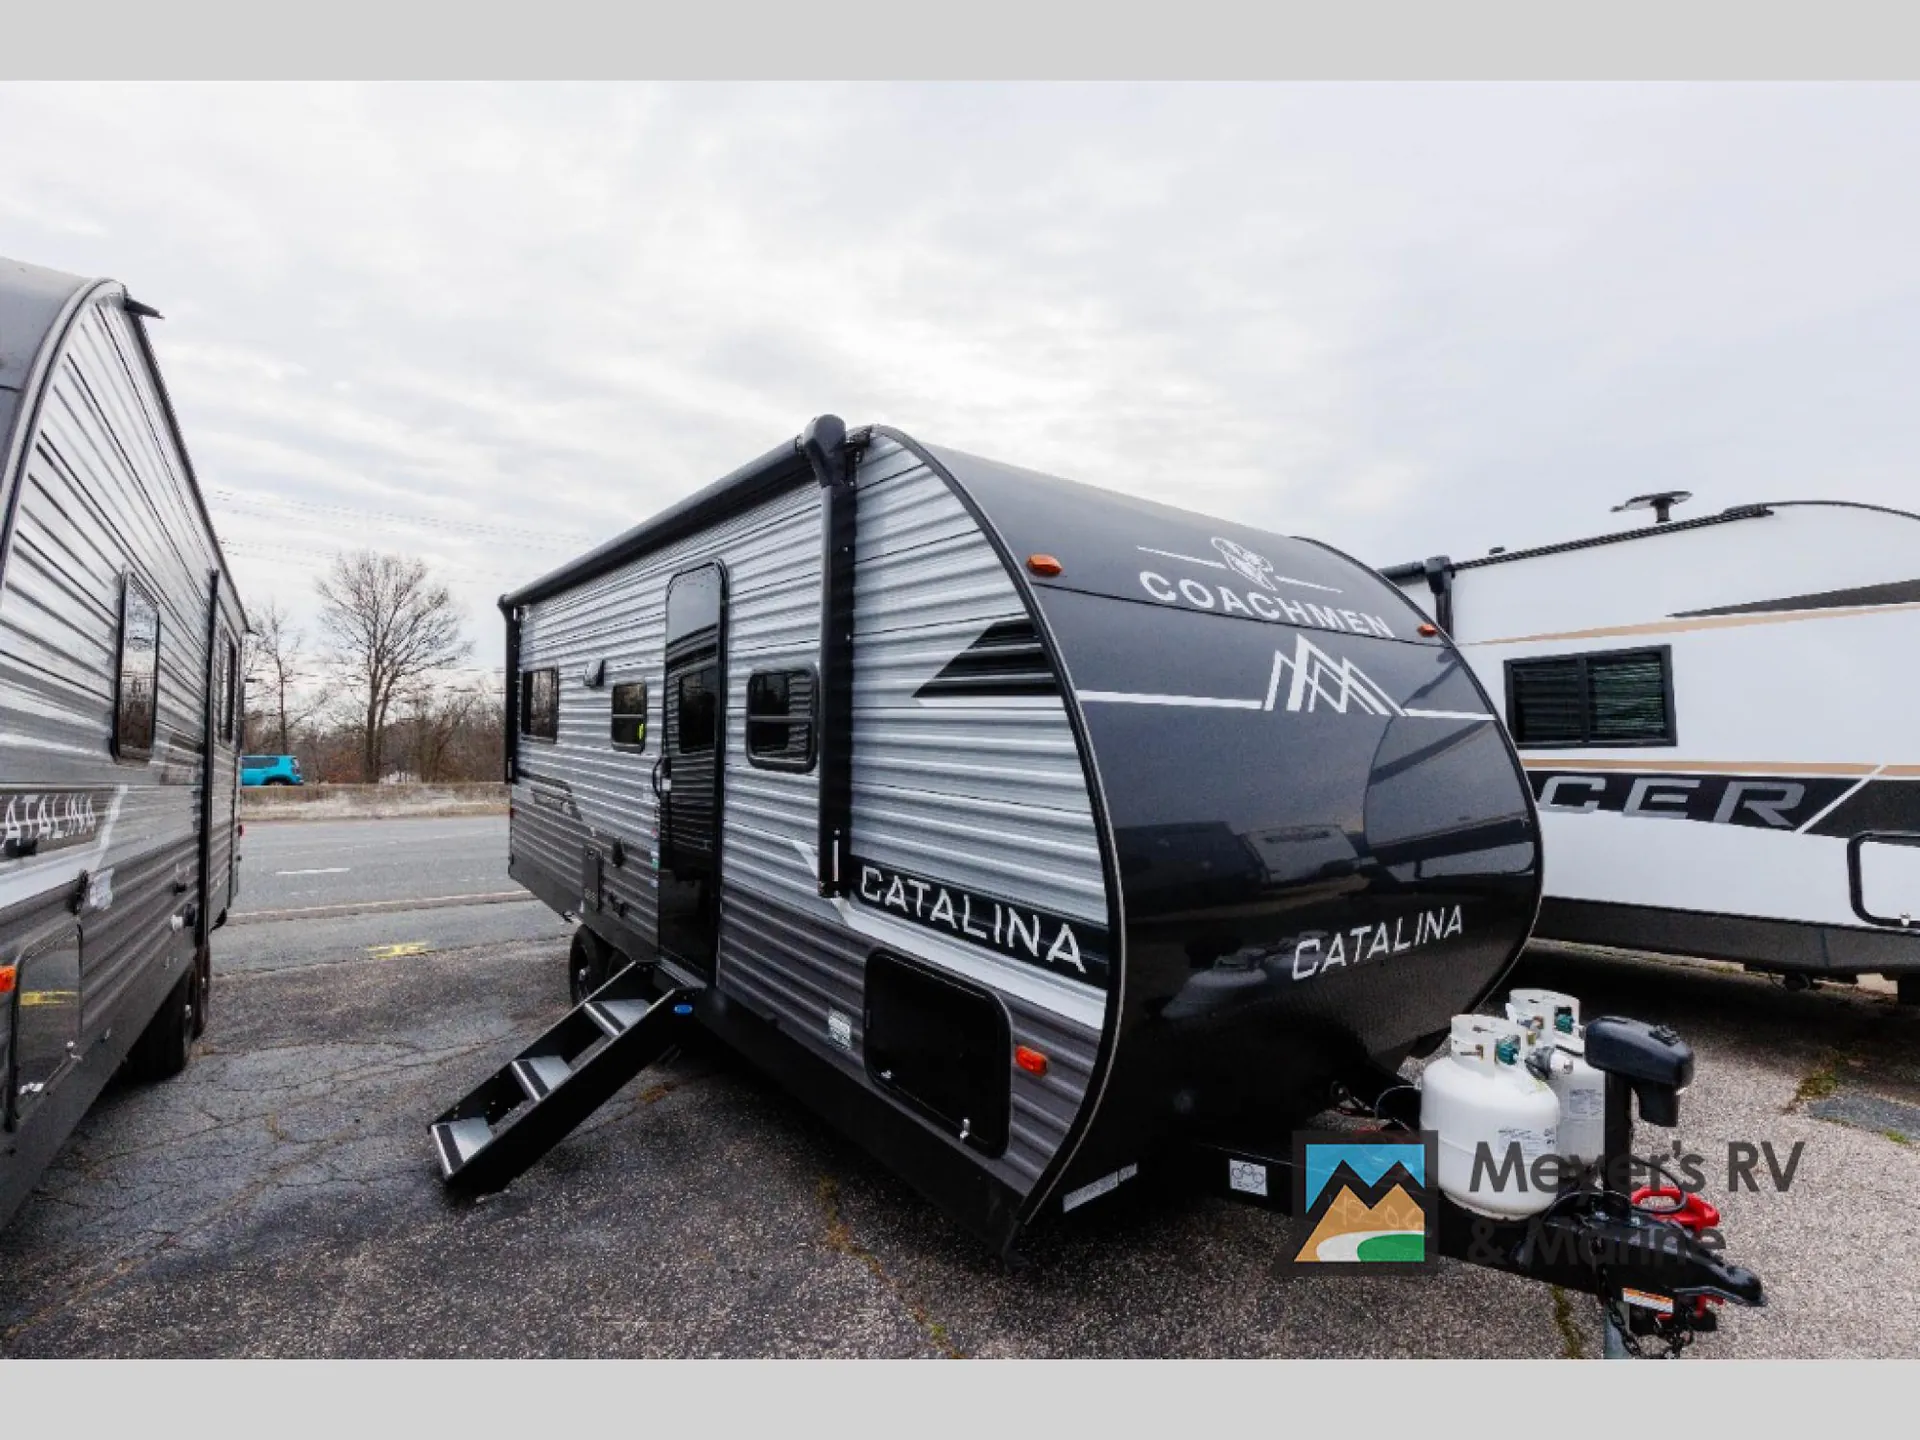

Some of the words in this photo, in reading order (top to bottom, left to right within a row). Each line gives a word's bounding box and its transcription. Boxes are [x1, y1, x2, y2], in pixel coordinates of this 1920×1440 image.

[1139, 571, 1396, 638] COACHMEN
[0, 792, 96, 848] ATALINA
[860, 865, 1087, 974] CATALINA
[1292, 904, 1463, 981] CATALINA
